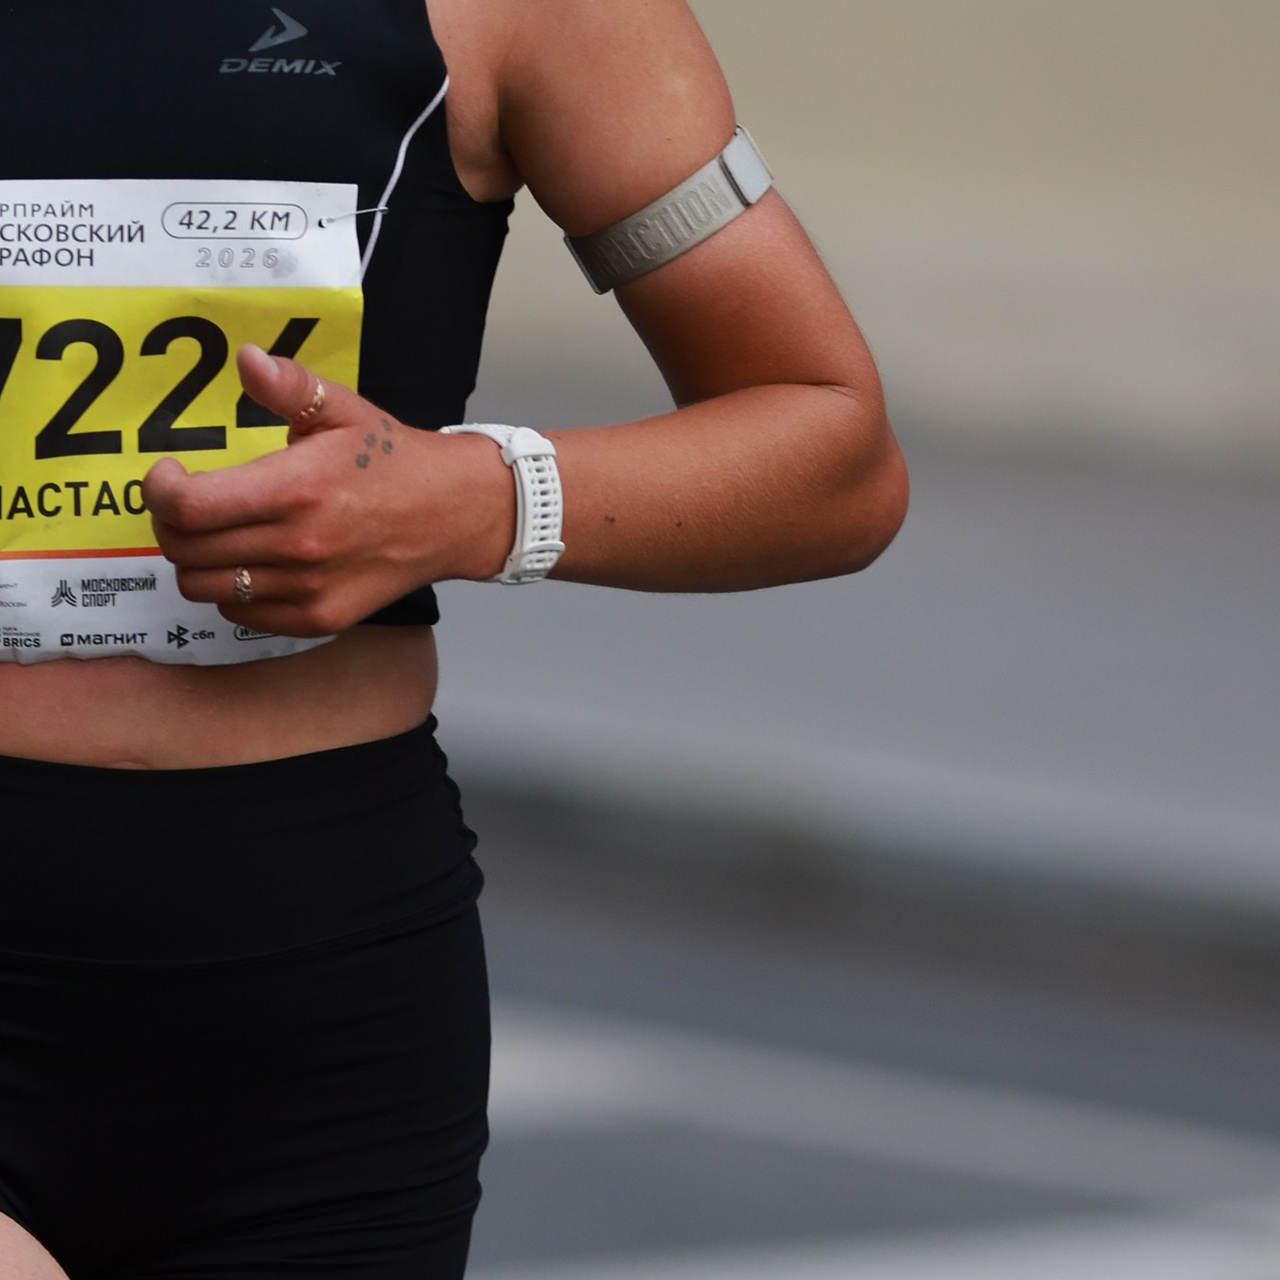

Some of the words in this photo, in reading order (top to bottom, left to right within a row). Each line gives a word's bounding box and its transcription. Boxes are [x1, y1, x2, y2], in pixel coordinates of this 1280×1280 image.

[218, 58, 342, 76] DEMIX
[178, 209, 238, 233] 42,2
[195, 247, 279, 269] 2026
[81, 574, 157, 593] МОСКОВСКИЙ
[81, 593, 117, 608] СПОРТ
[2, 637, 41, 648] BRICS
[77, 632, 149, 646] магнит
[191, 630, 216, 641] сбп
